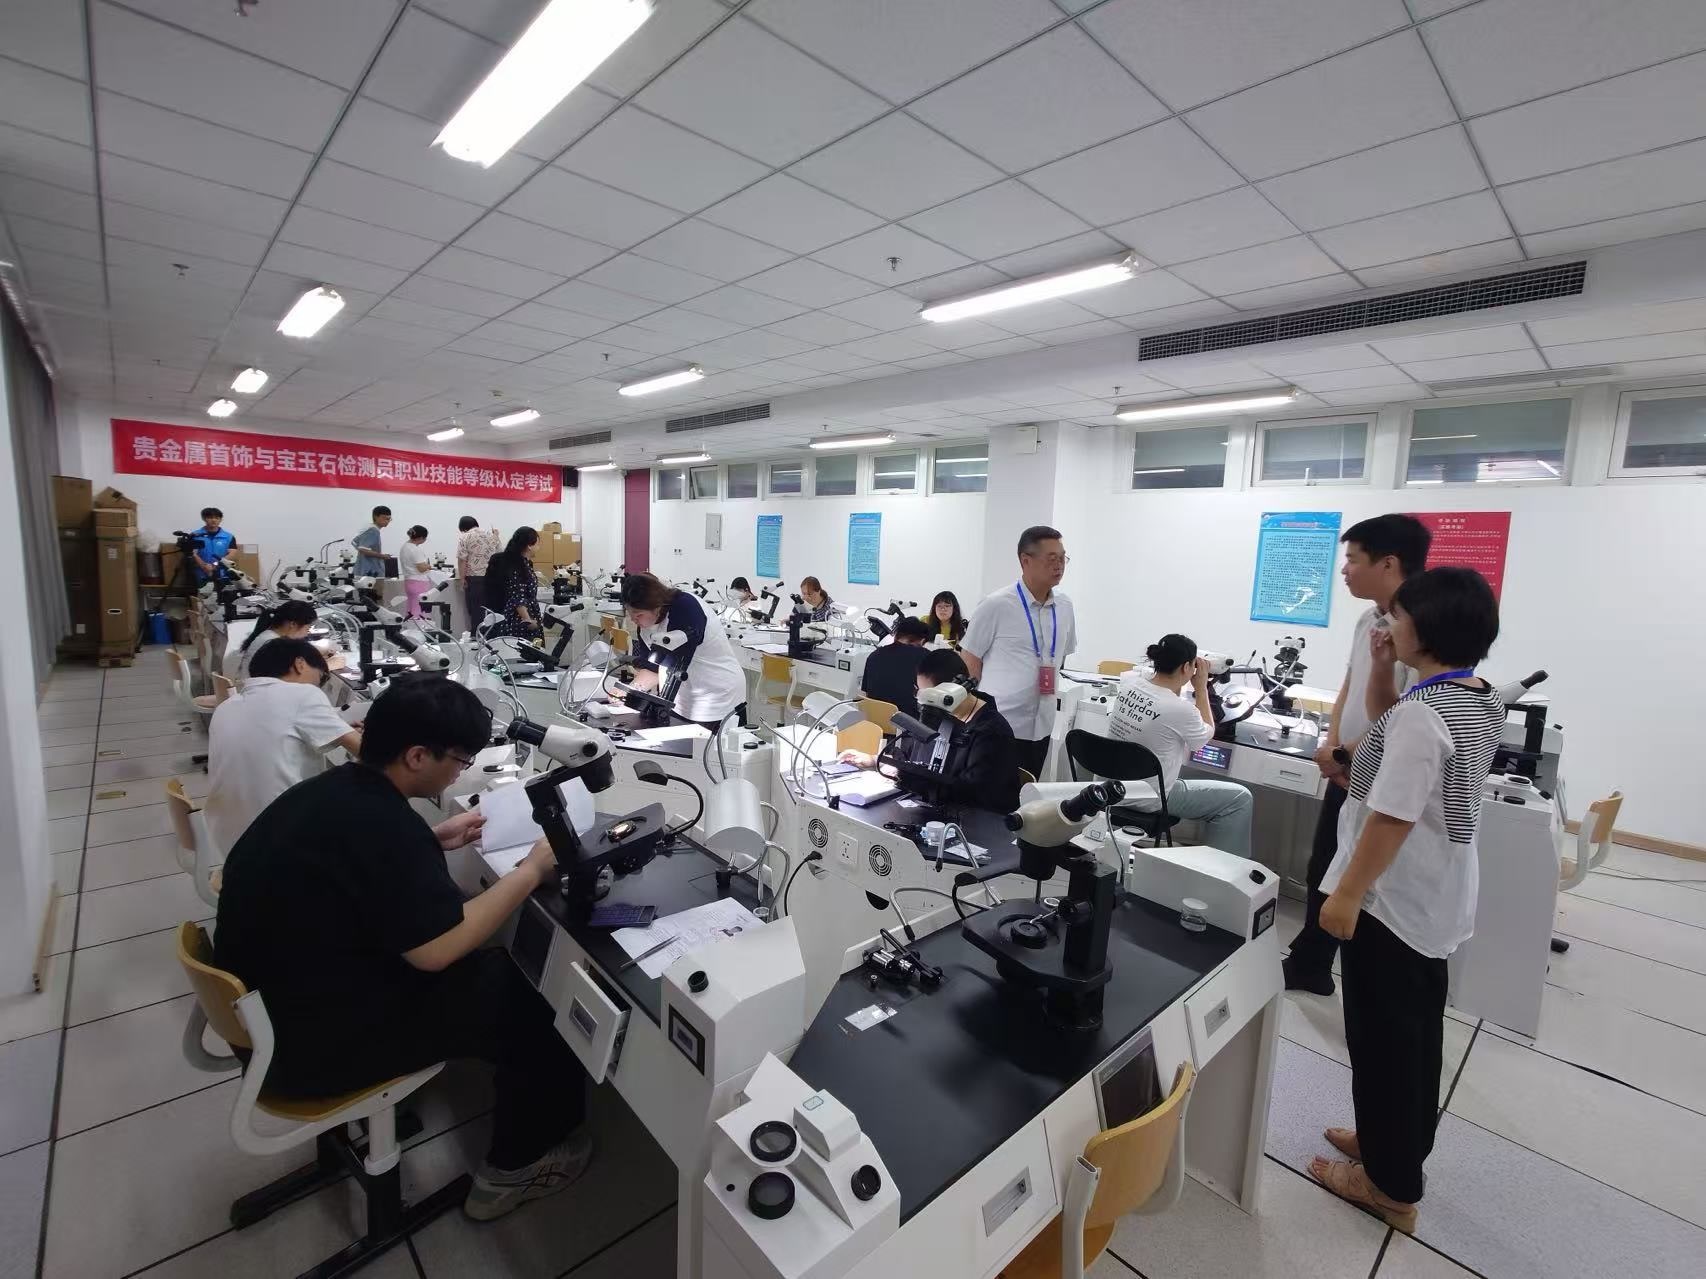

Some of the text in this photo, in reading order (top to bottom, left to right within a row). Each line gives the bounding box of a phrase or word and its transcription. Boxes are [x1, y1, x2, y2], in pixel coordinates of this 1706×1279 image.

[132, 436, 554, 493] 贵金属首饰与宝玉石检测员职业技能等级认定考试
[1127, 689, 1154, 707] this's
[1126, 708, 1143, 723] fine
